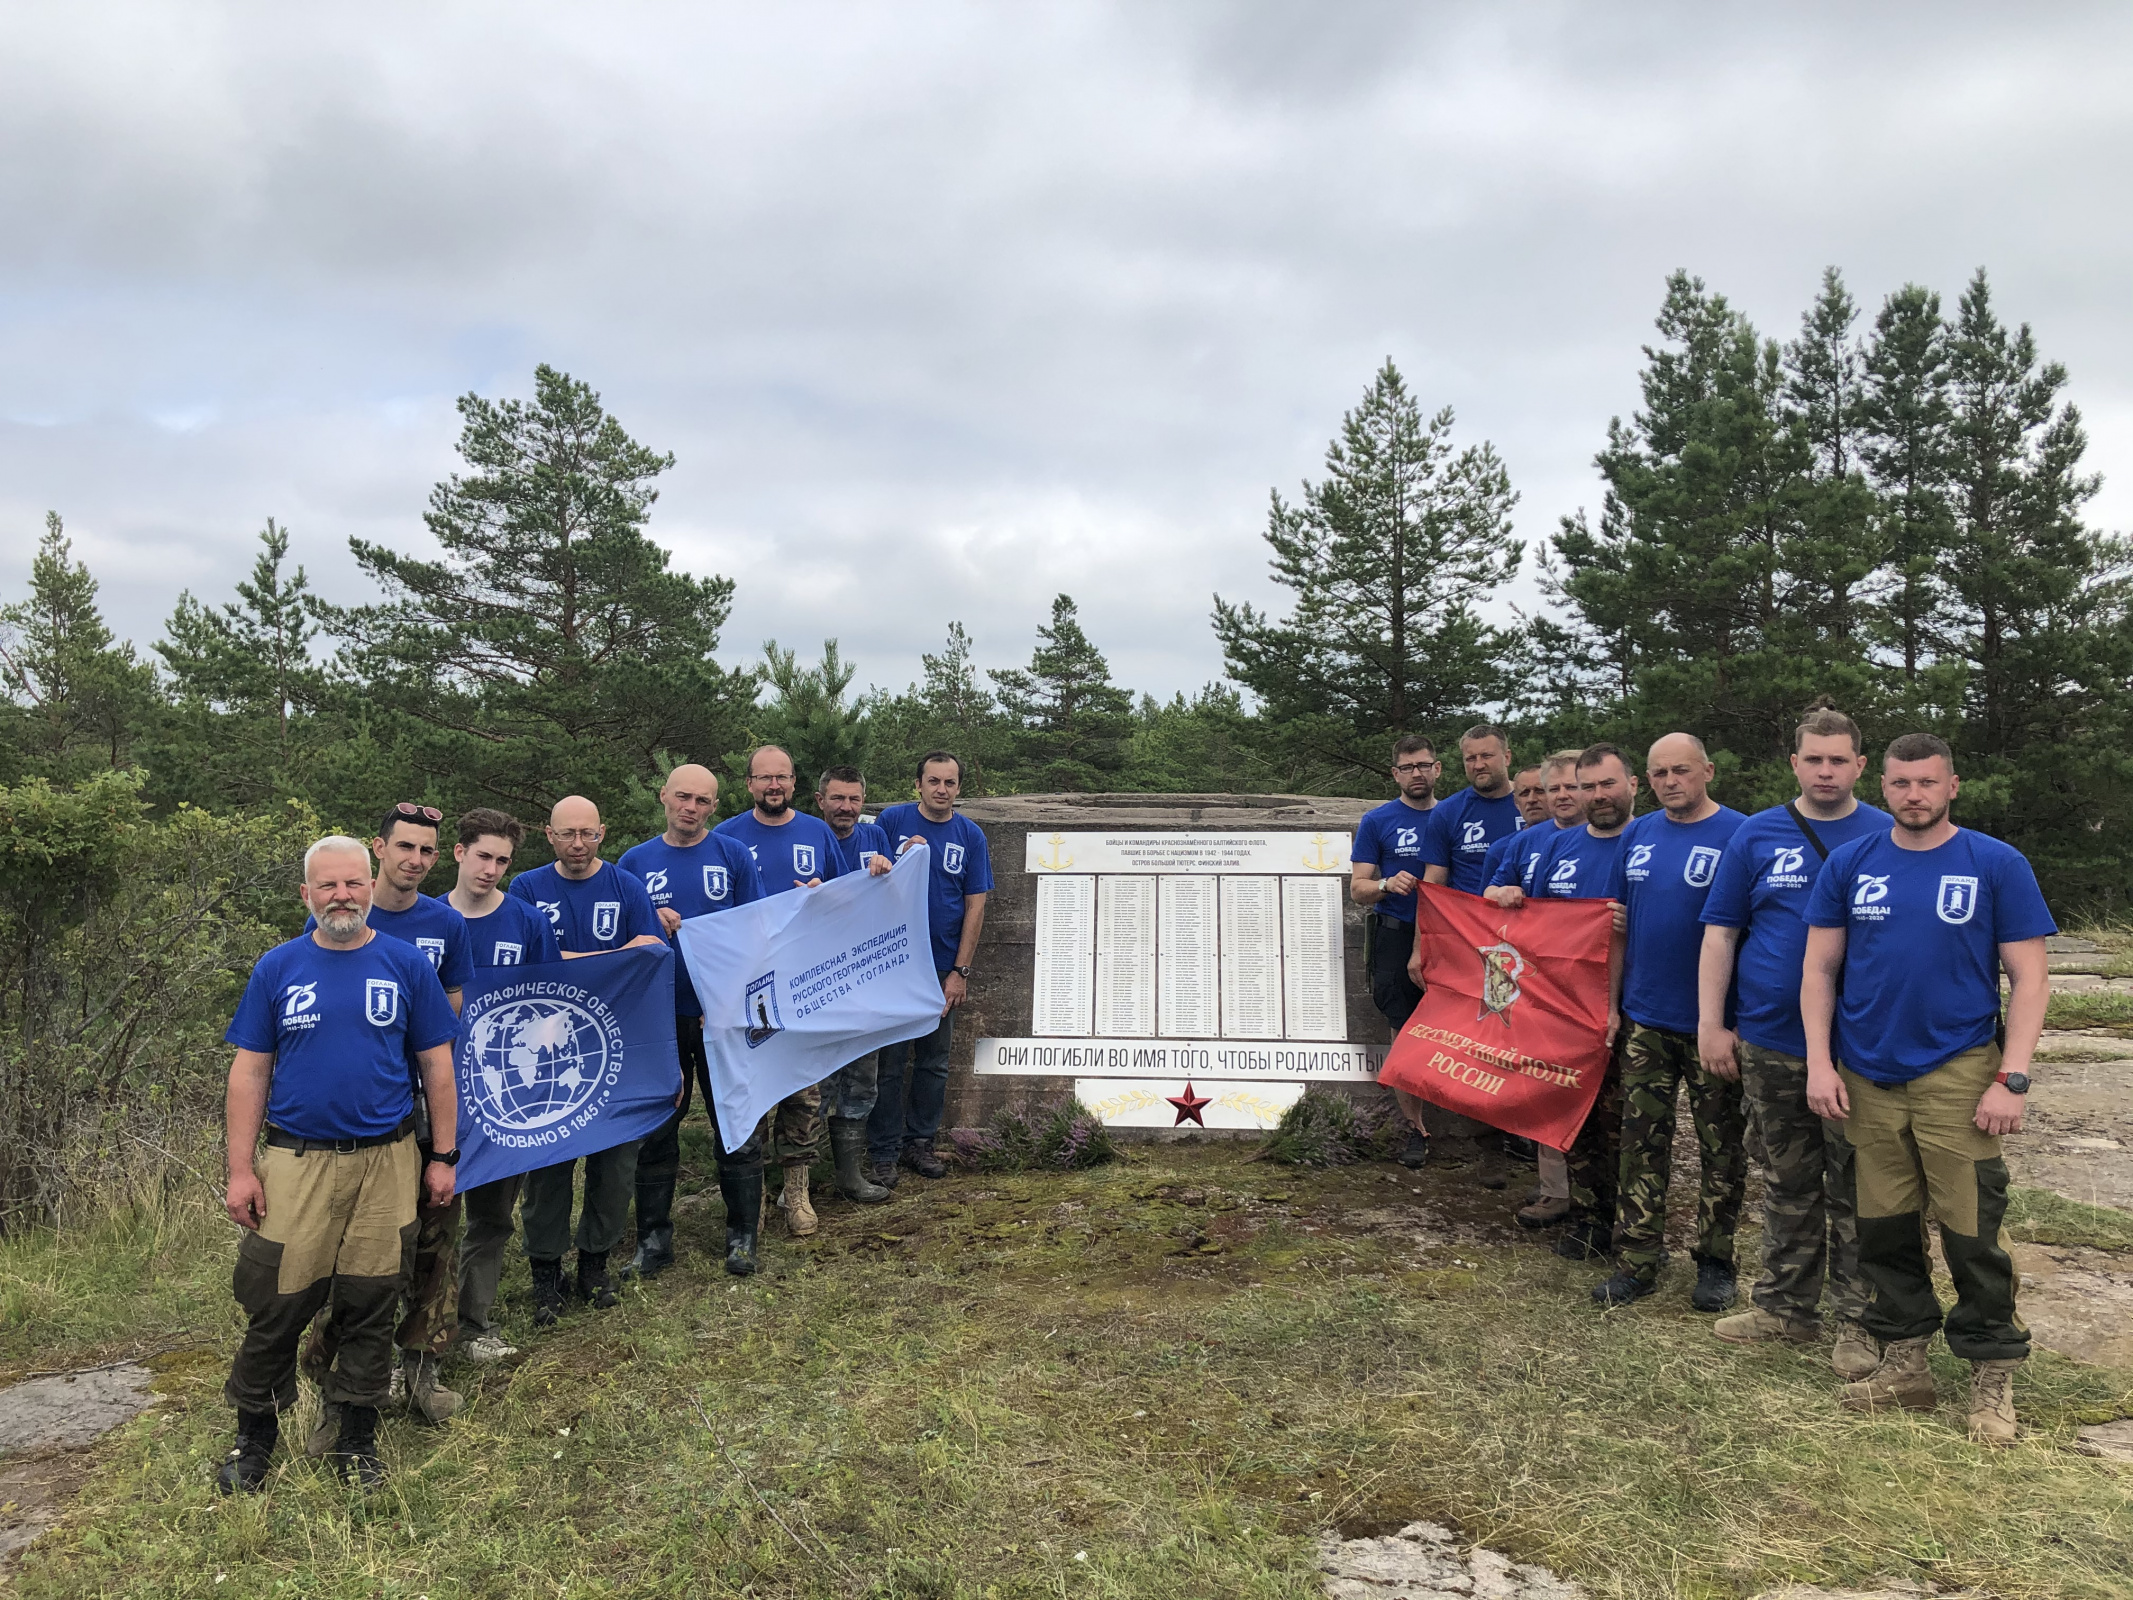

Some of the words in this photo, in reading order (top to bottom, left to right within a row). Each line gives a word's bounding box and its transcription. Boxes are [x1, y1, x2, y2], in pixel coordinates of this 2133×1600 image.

[1397, 826, 1418, 847] 75
[1463, 820, 1486, 844] 75
[1551, 857, 1580, 881] 75
[1627, 844, 1656, 869] 75
[1772, 846, 1804, 874] 75
[646, 868, 668, 894] 75
[1766, 875, 1808, 884] ПОБЕДА!
[1854, 874, 1890, 905] 75
[650, 892, 673, 901] БЕДА!
[1851, 906, 1890, 915] ПОБЕДА!
[789, 952, 847, 990] КОМПЛЕКСНАЯ
[851, 923, 907, 957] ЭКСПЕДИЦИЯ
[367, 980, 397, 988] ГОГЛАНД
[746, 973, 774, 993] ГОГЛАНД
[792, 976, 832, 1005] РУССКОГО
[833, 937, 908, 983] ГЕОГРАФИЧЕСКОГО
[285, 981, 317, 1016] 75
[796, 983, 852, 1019] ОБЩЕСТВА
[856, 953, 910, 986] «ГОГЛАНД»
[468, 981, 588, 1020] ОГРАФИЧЕСКОЕ
[282, 1013, 321, 1027] ПОБЕДА!
[587, 996, 624, 1086] ОБЩЕСТВО
[998, 1046, 1028, 1066] ОНИ
[1033, 1047, 1104, 1067] ПОГИБЛИ
[1108, 1048, 1128, 1068] ВО
[1133, 1049, 1166, 1068] ИМЯ
[1171, 1049, 1213, 1071] ТОГО,
[1218, 1050, 1271, 1070] ЧТОБЫ
[1275, 1051, 1351, 1073] РОДИЛСЯ
[1407, 1023, 1518, 1072] БЕССМЕРТНЫЙ
[1519, 1055, 1582, 1089] ПОЛК
[461, 1040, 478, 1117] РУССКО
[1427, 1051, 1506, 1096] РОССИИ
[482, 1122, 558, 1148] ОСНОВАНО
[557, 1125, 571, 1139] В
[570, 1103, 599, 1131] 1845
